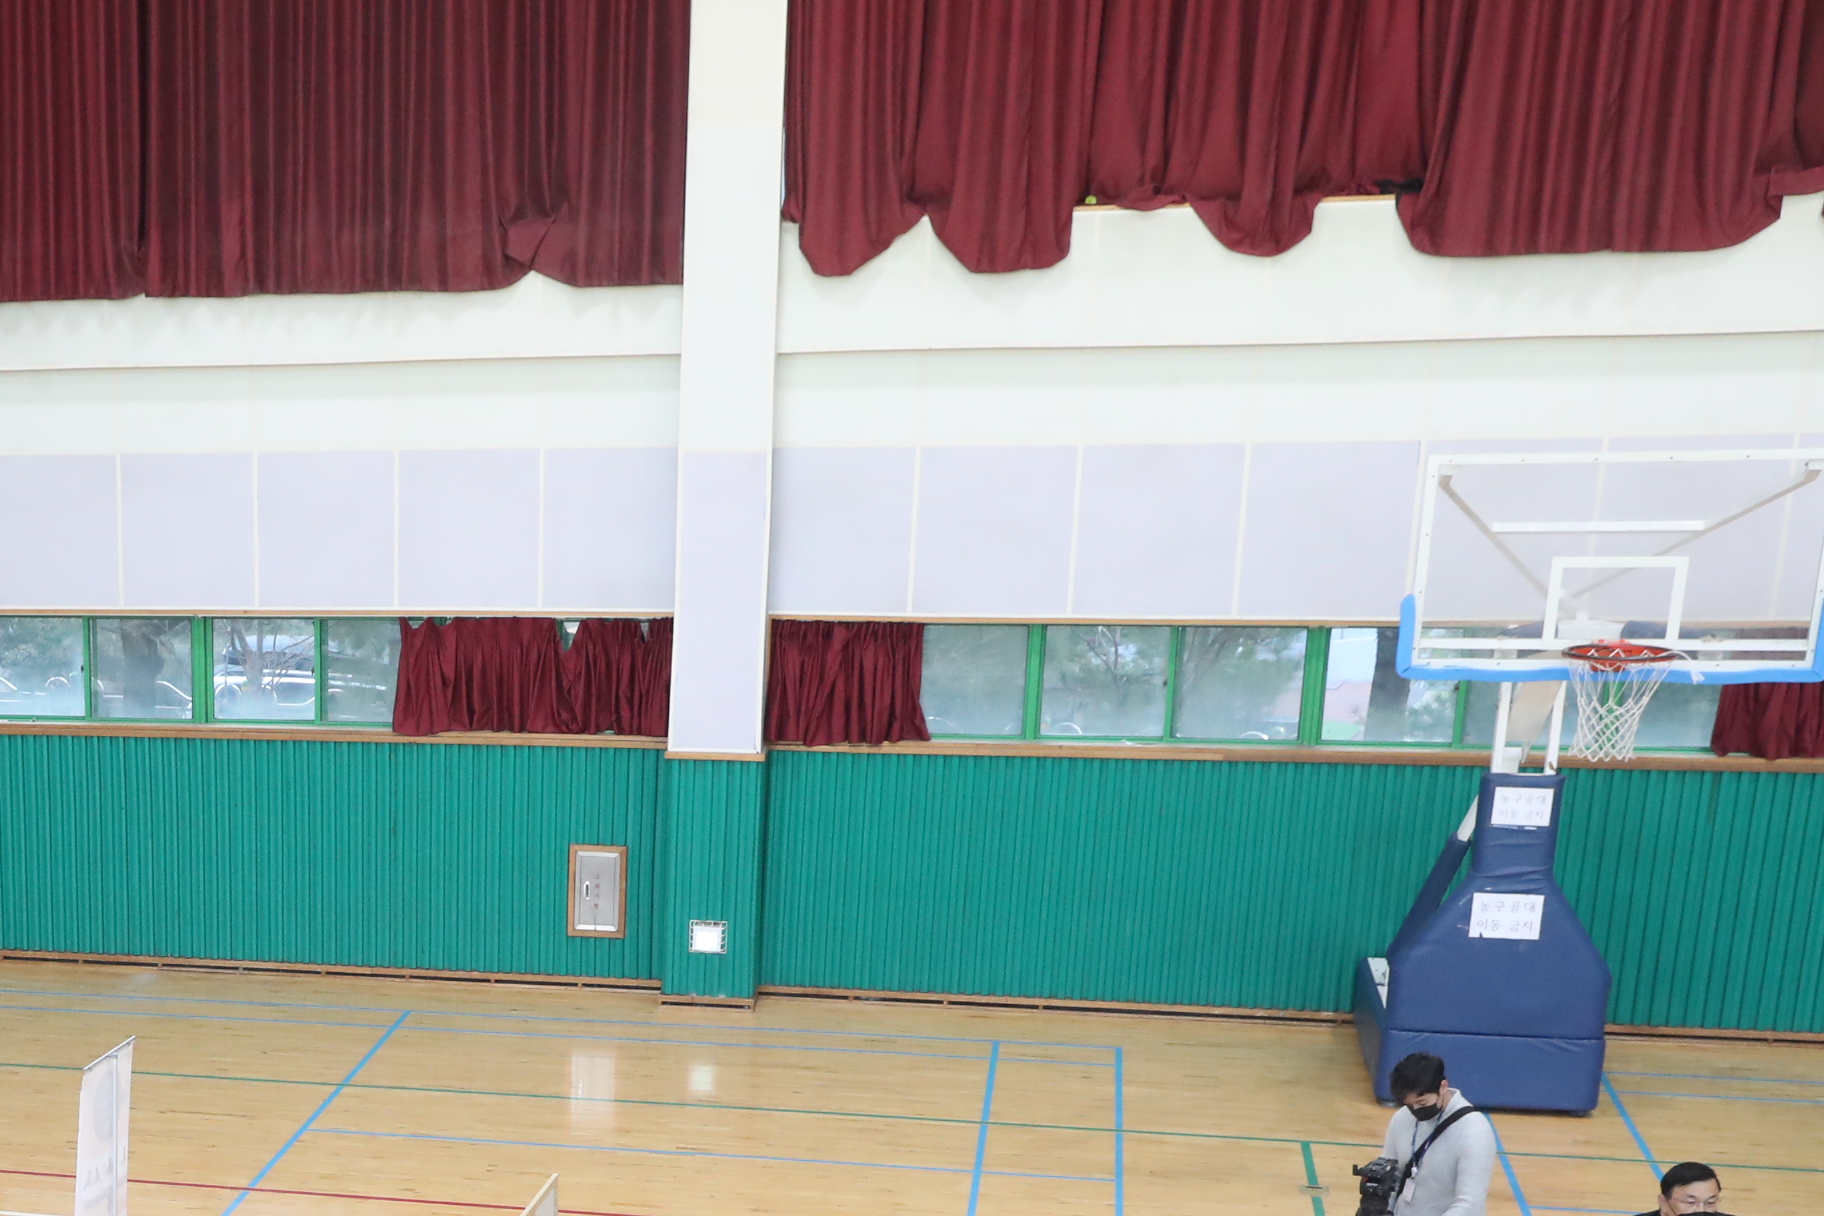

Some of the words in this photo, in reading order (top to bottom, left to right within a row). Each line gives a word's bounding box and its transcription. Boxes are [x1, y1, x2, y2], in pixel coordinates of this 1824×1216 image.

[1479, 900, 1537, 914] 농구골대
[1476, 918, 1501, 931] 이동
[1509, 919, 1533, 933] 금지
